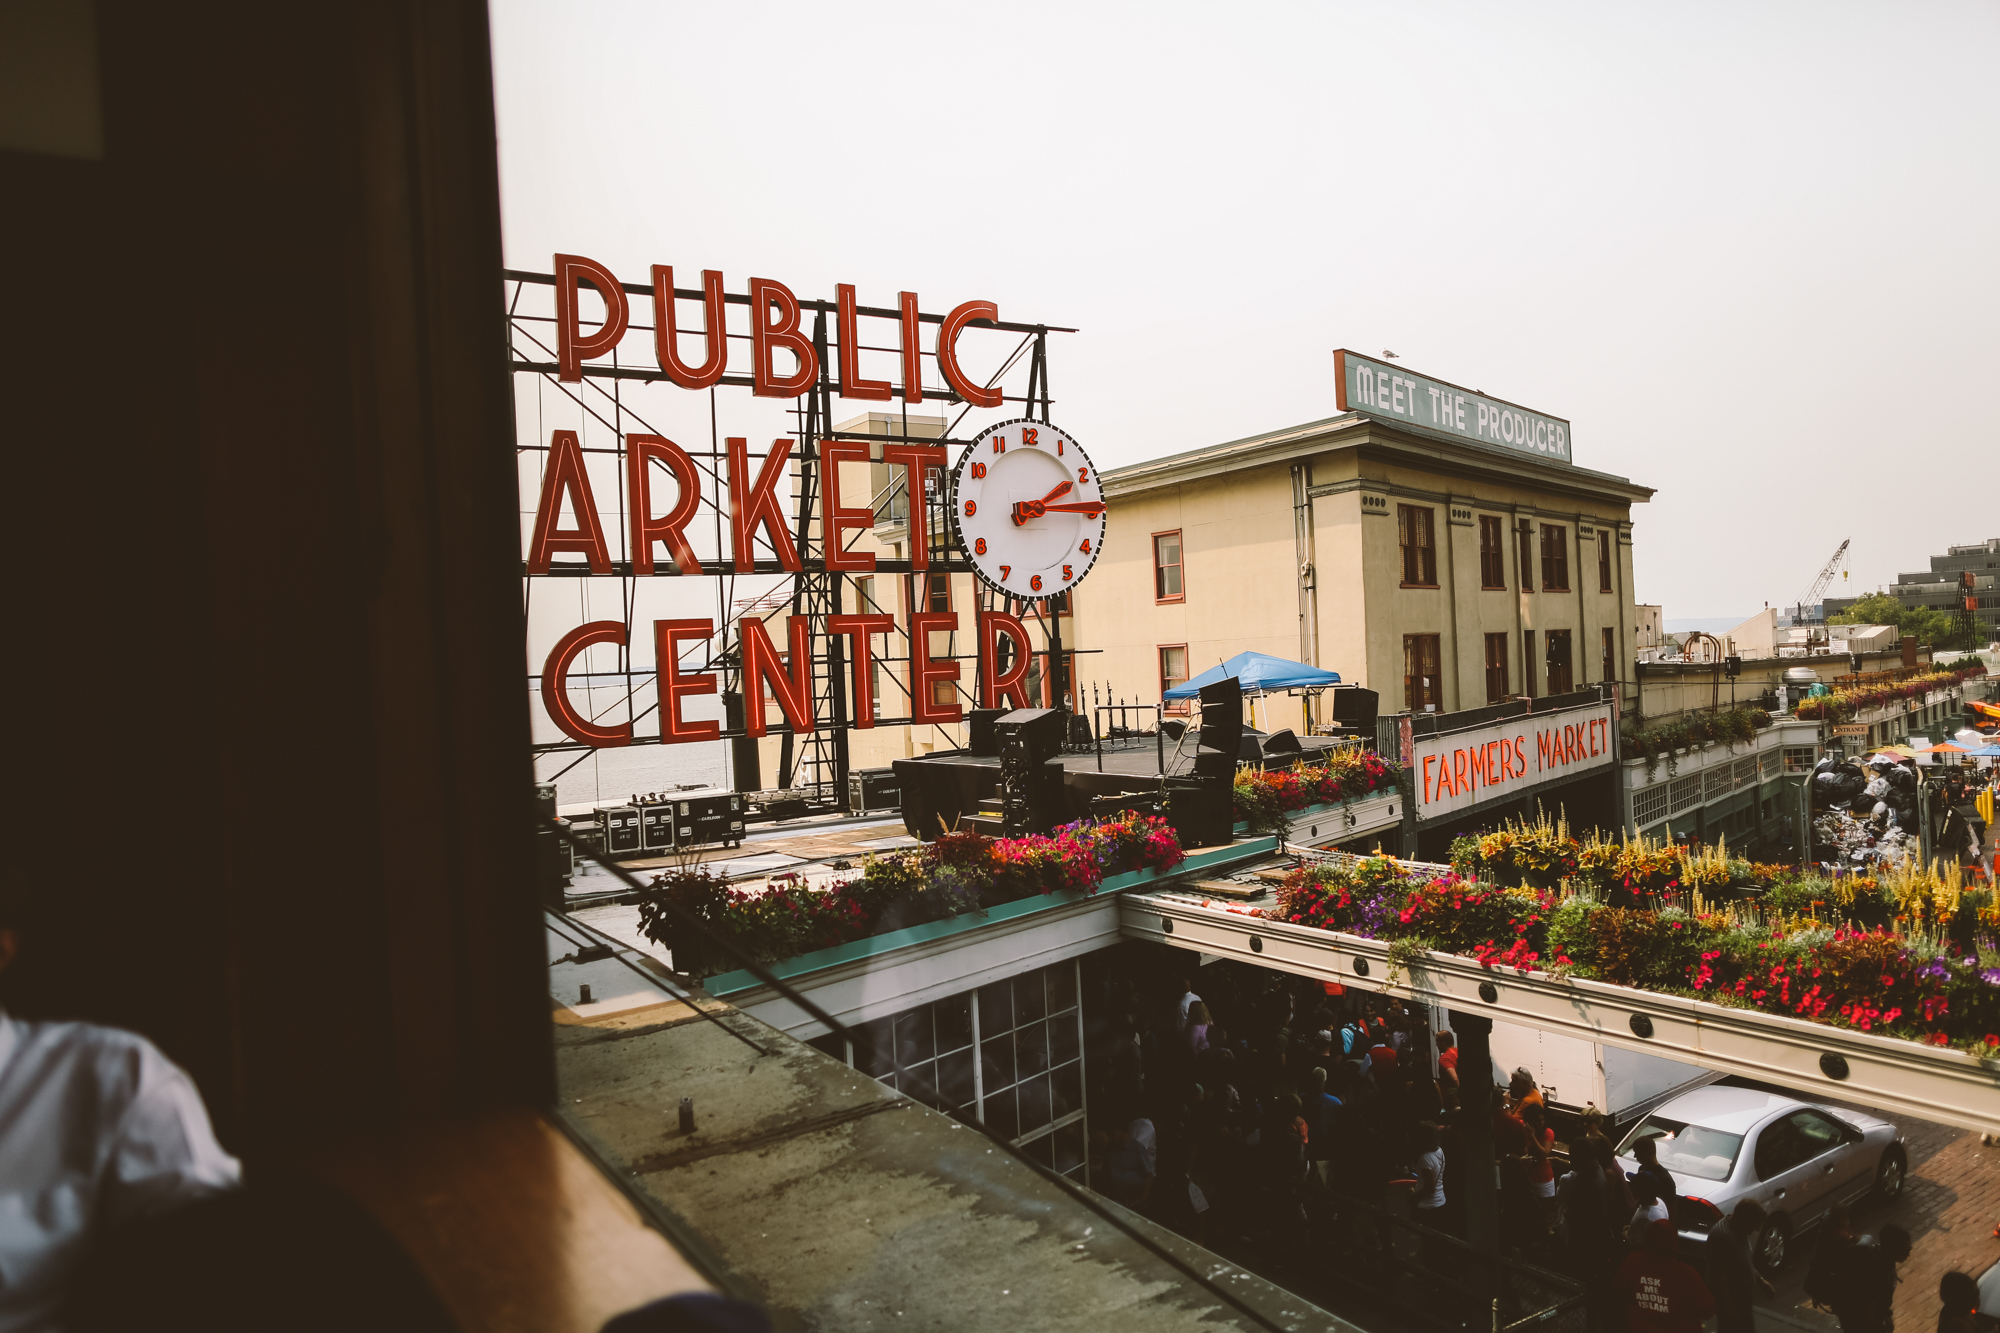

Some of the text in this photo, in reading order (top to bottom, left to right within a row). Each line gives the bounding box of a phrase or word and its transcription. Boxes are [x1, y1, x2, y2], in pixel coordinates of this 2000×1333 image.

[553, 253, 1003, 407] PUBLIC
[1356, 364, 1566, 455] MEET THE PRODUCER
[993, 436, 1005, 453] 11
[1022, 428, 1038, 445] 12
[1057, 440, 1064, 456] 1
[971, 462, 987, 479] 10
[1078, 467, 1089, 483] 2
[964, 500, 977, 517] 9
[975, 538, 987, 555] 8
[1079, 539, 1092, 554] 4
[999, 565, 1011, 582] 7
[1062, 565, 1073, 580] 5
[1030, 575, 1042, 591] 6
[541, 611, 1032, 747] CENTER
[1423, 717, 1608, 804] FARMERS MARKET
[1640, 1276, 1661, 1287] ASK
[1644, 1285, 1659, 1294] ME
[1636, 1292, 1669, 1305] ABOUT
[1638, 1300, 1669, 1313] ISLAM
